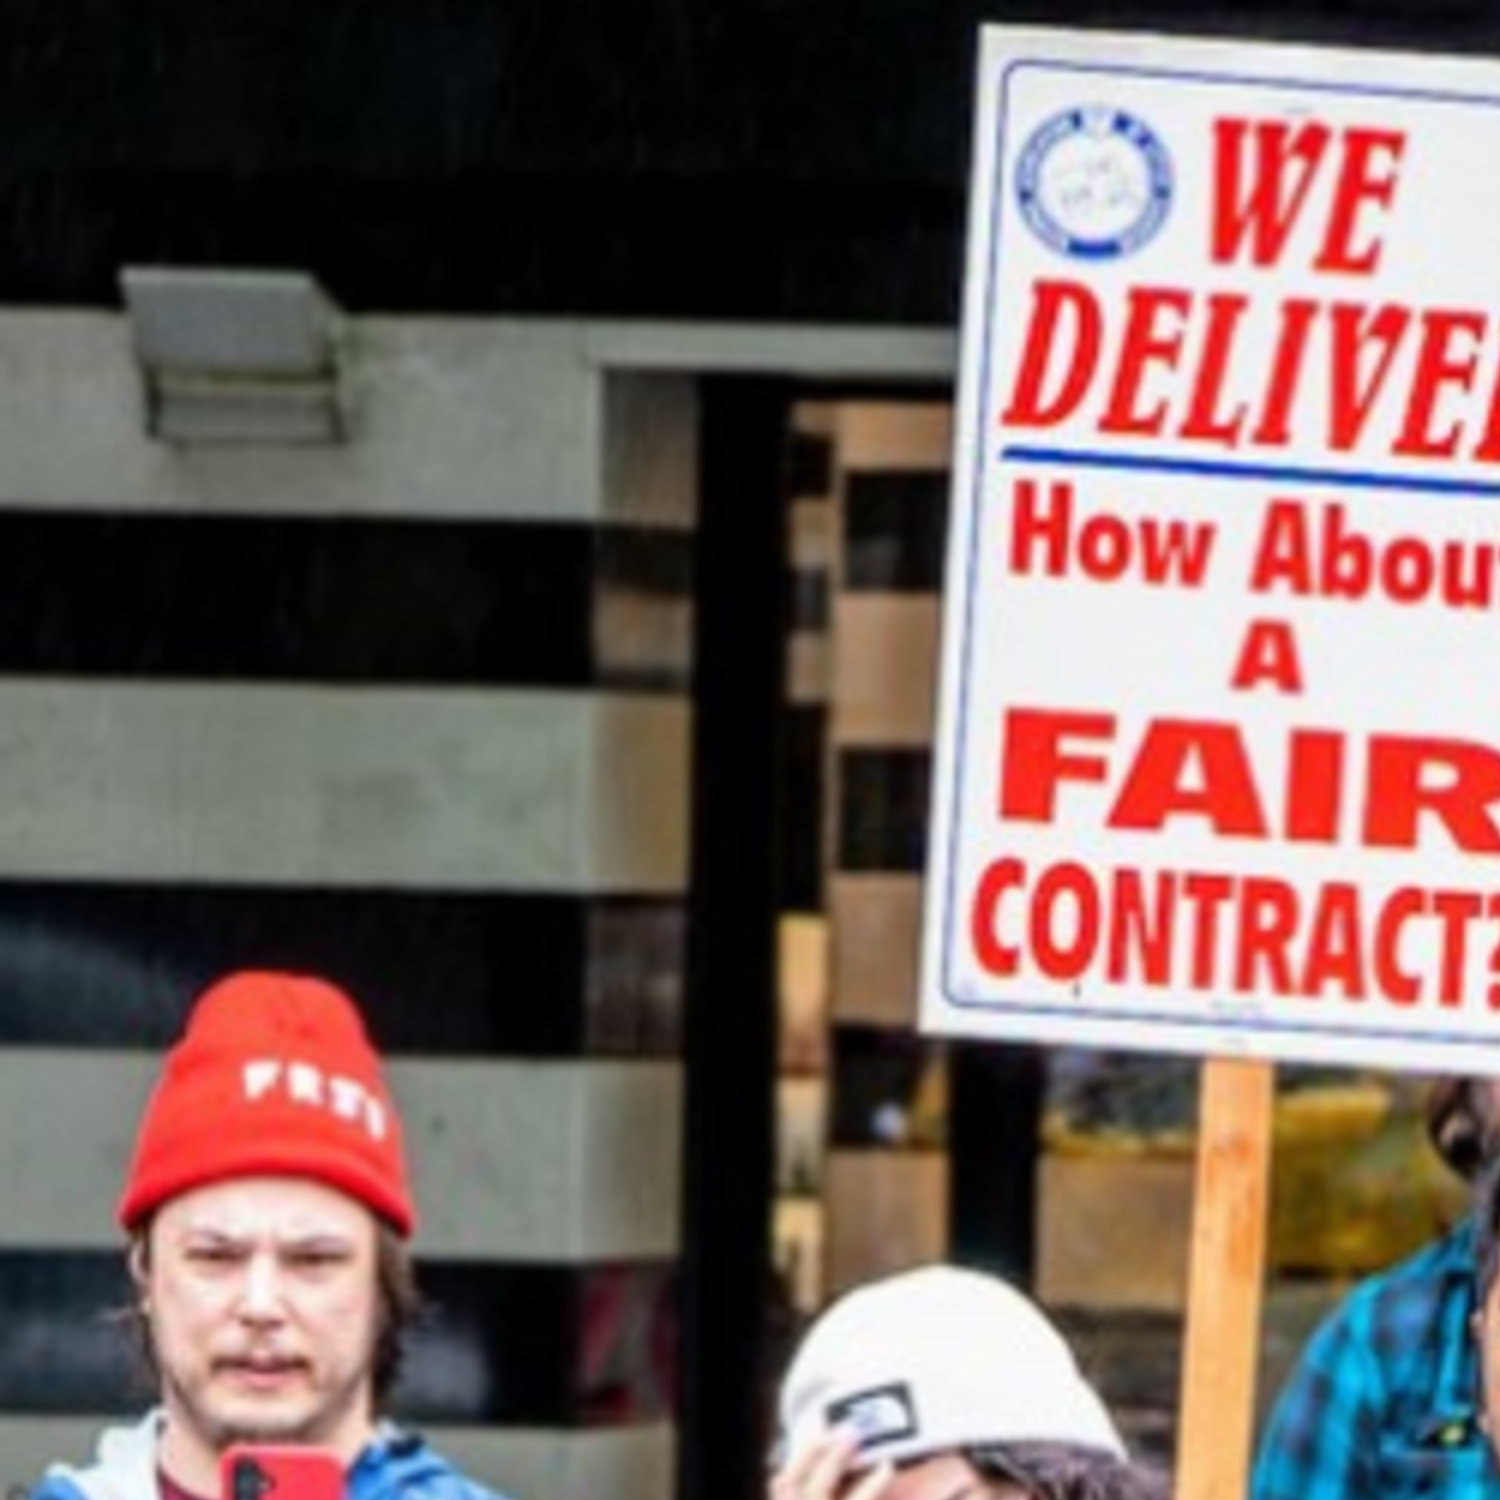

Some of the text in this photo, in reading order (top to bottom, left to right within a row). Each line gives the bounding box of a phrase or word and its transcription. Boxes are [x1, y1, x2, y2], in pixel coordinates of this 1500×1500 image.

[1208, 115, 1407, 276] WE
[1007, 479, 1216, 588] How
[1229, 618, 1304, 694] A
